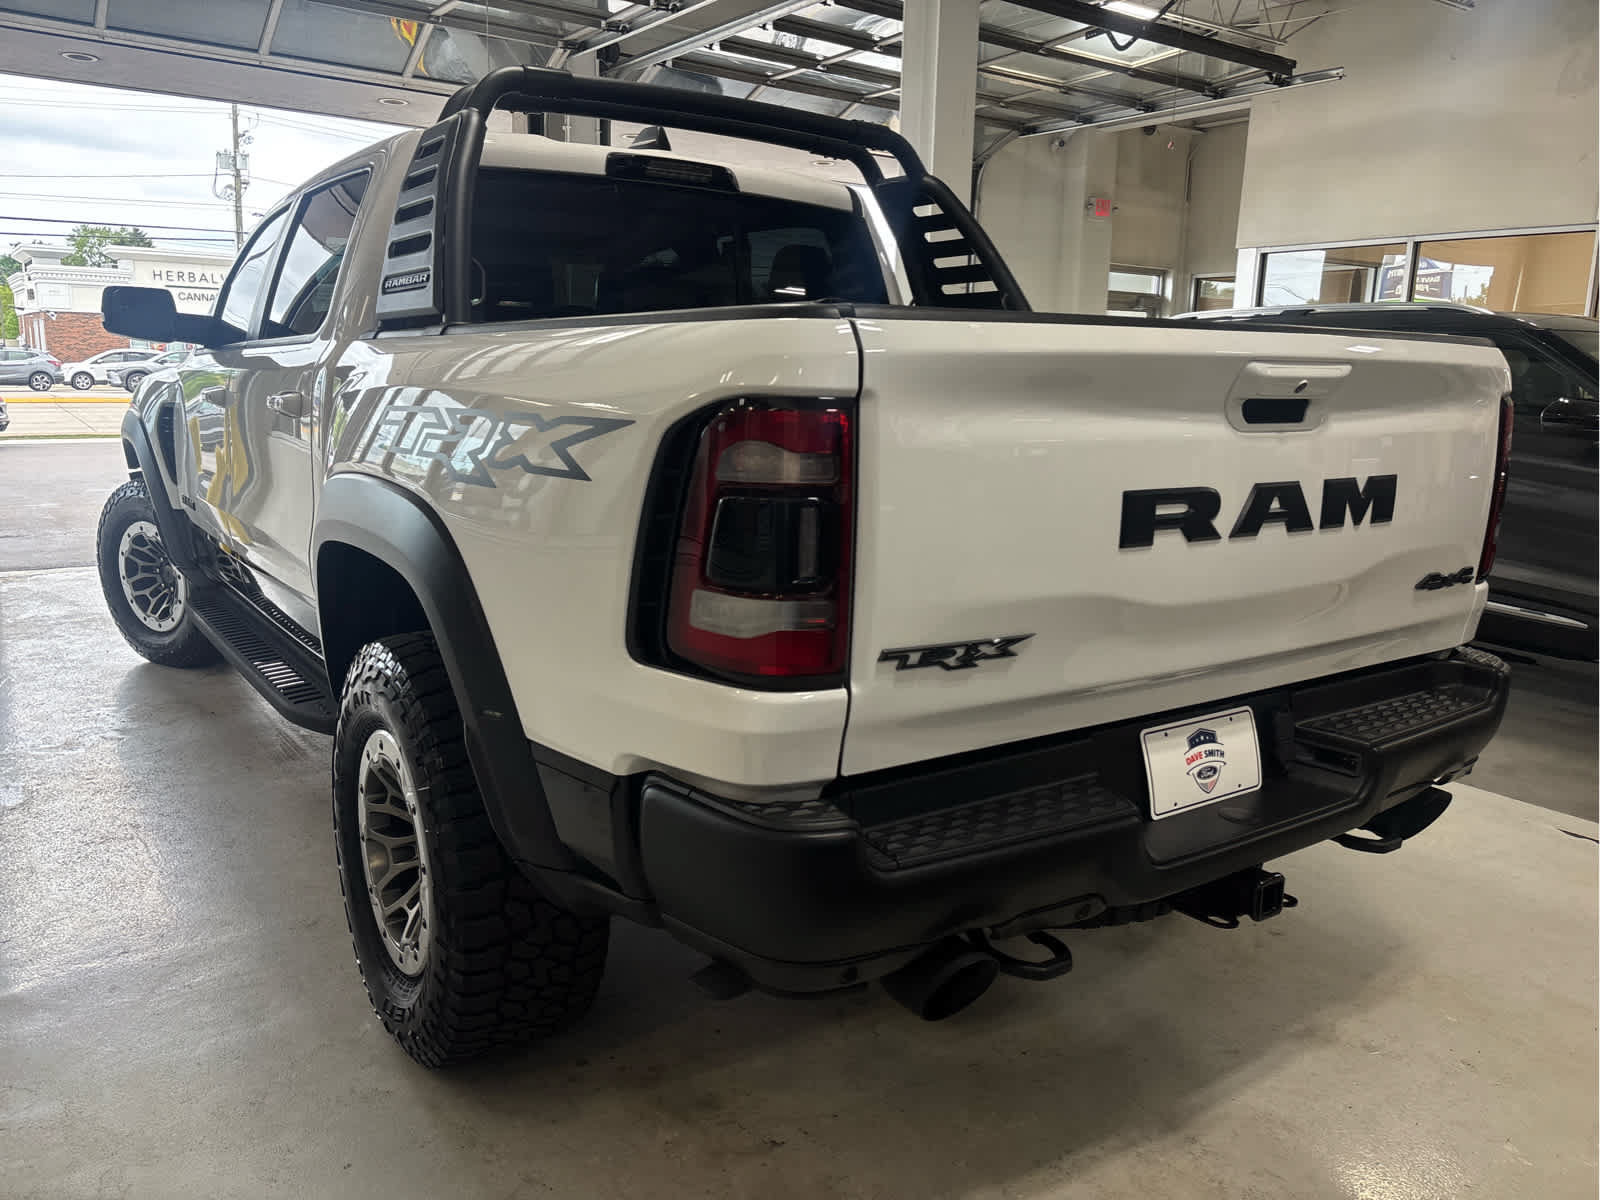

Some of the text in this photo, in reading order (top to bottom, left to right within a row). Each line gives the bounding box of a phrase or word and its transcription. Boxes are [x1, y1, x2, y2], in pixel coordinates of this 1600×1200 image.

[385, 273, 427, 288] RAMBAR
[177, 292, 218, 302] CANNA
[379, 404, 636, 488] TRX
[1119, 474, 1397, 549] RAM
[877, 633, 1037, 671] TRX
[1185, 749, 1224, 766] DAVE SMITH
